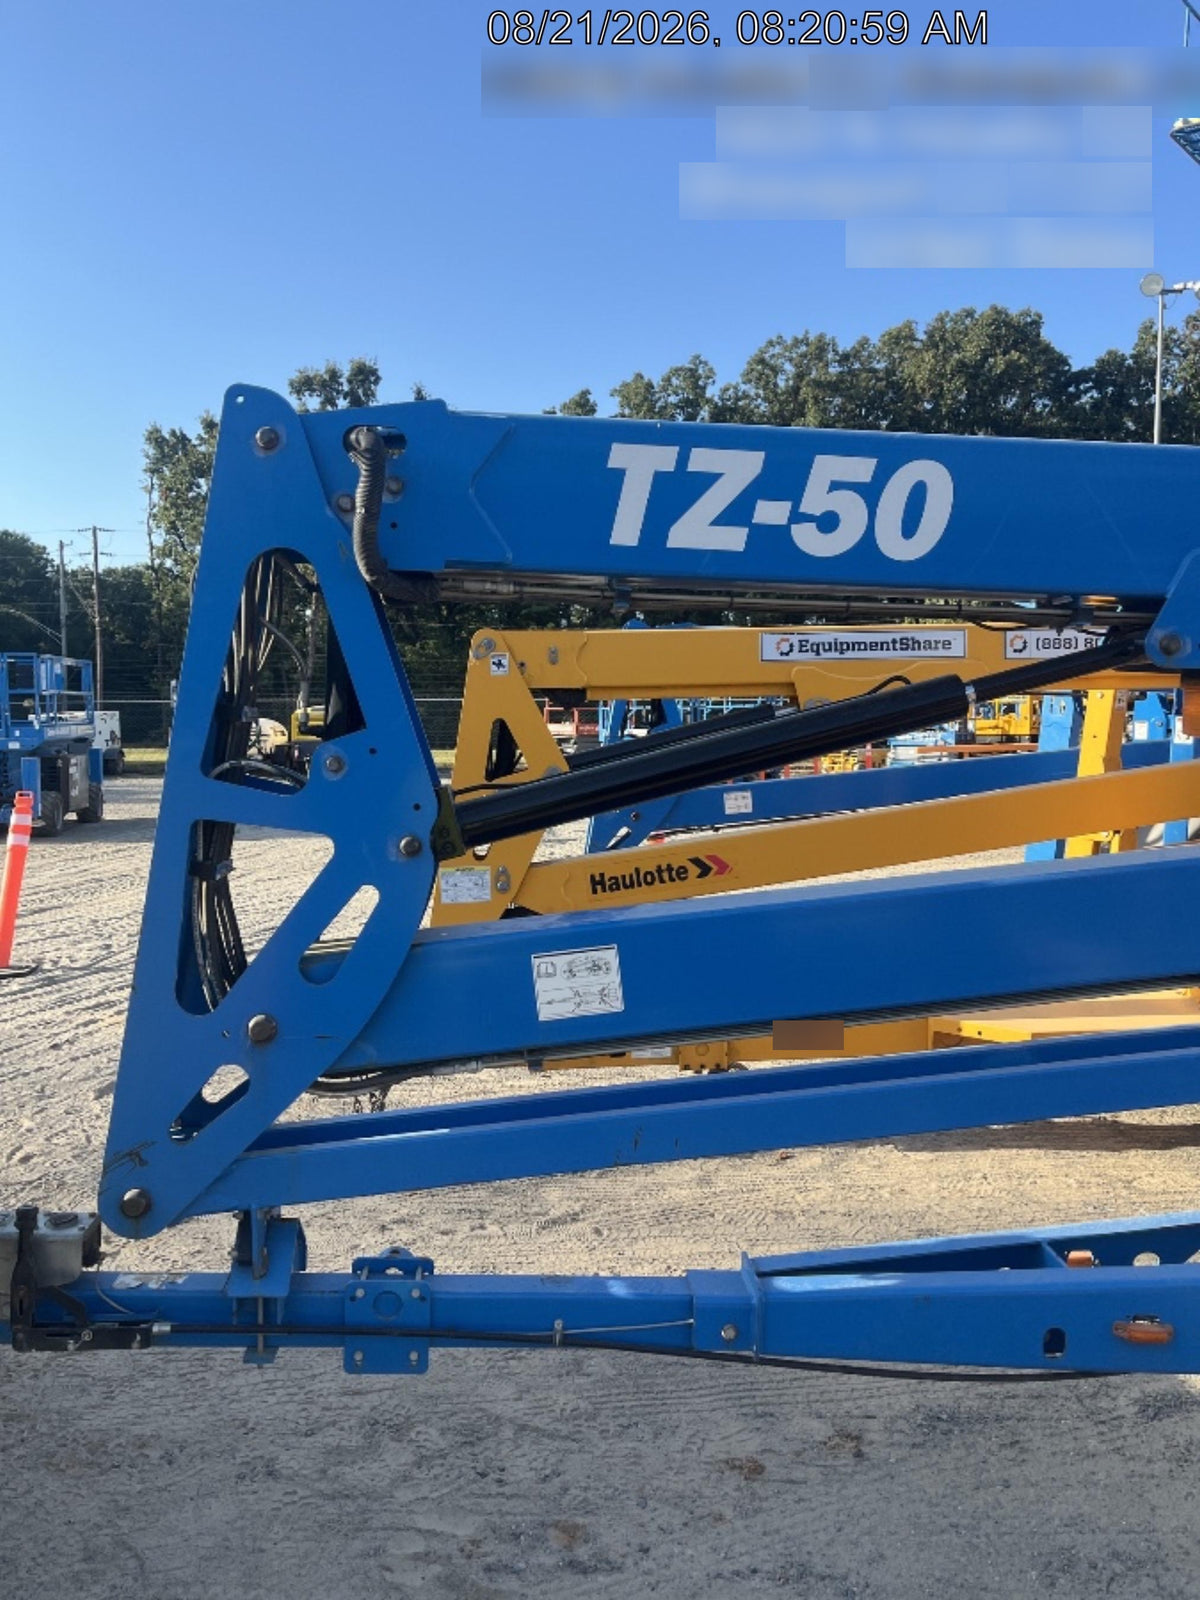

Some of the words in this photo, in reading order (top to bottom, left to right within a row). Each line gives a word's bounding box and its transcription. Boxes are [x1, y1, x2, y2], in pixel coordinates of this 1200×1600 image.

[607, 442, 954, 561] TZ-50
[798, 637, 953, 656] EquipmentShare
[1036, 636, 1079, 651] (888)
[589, 863, 690, 895] Haulotte
